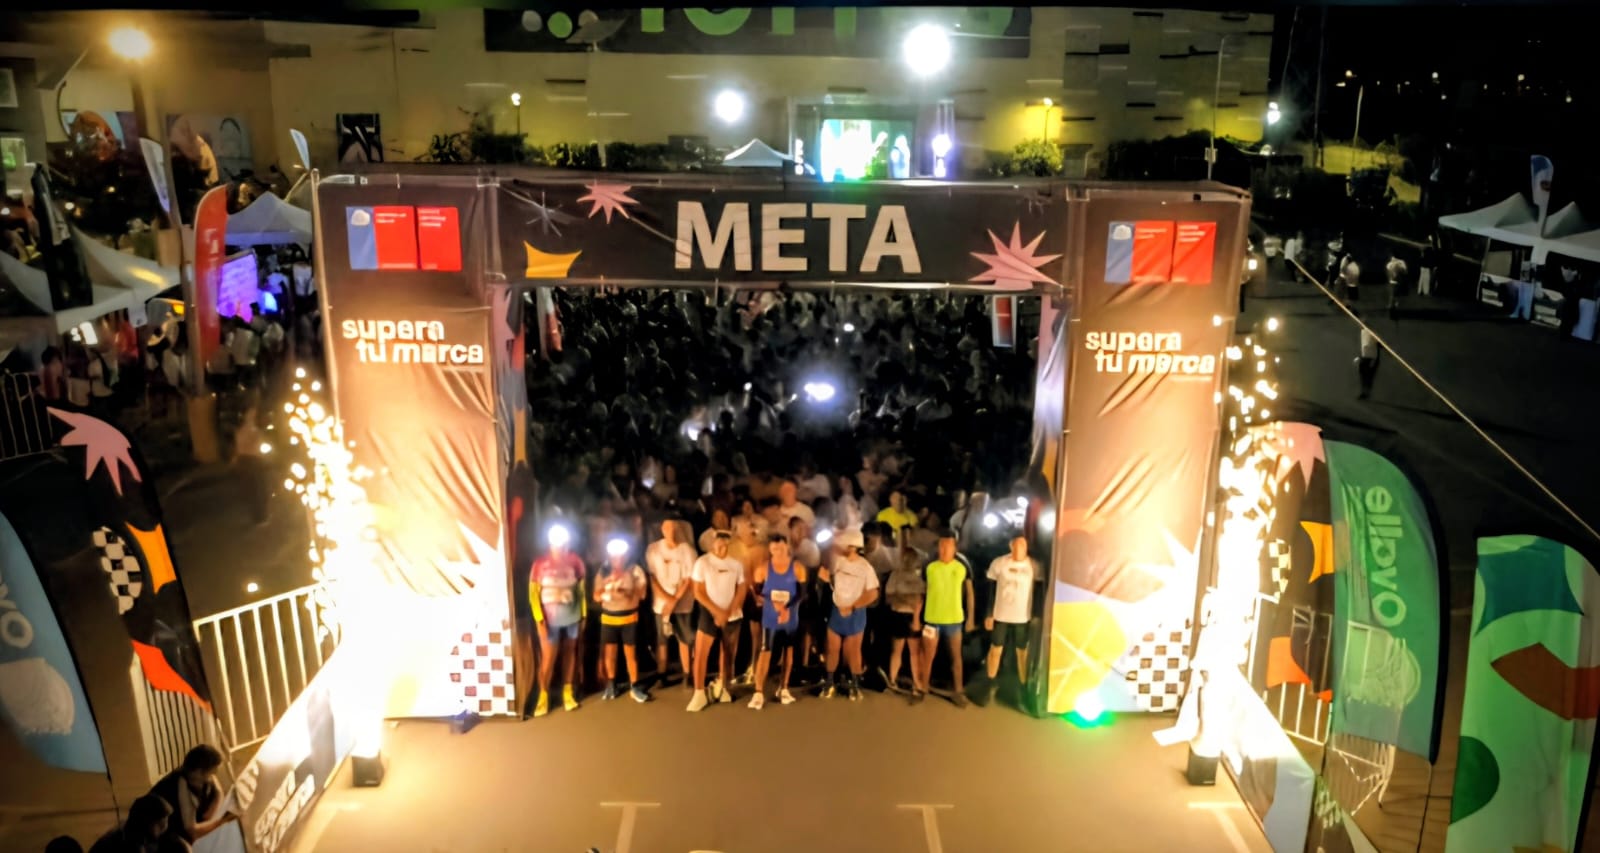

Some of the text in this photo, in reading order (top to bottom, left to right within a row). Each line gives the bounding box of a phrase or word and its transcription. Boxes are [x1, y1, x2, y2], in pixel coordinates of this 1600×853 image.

[675, 201, 922, 273] META
[342, 319, 445, 342] supera
[1085, 331, 1182, 353] supera
[355, 338, 387, 363] tu
[1094, 348, 1124, 373] tu
